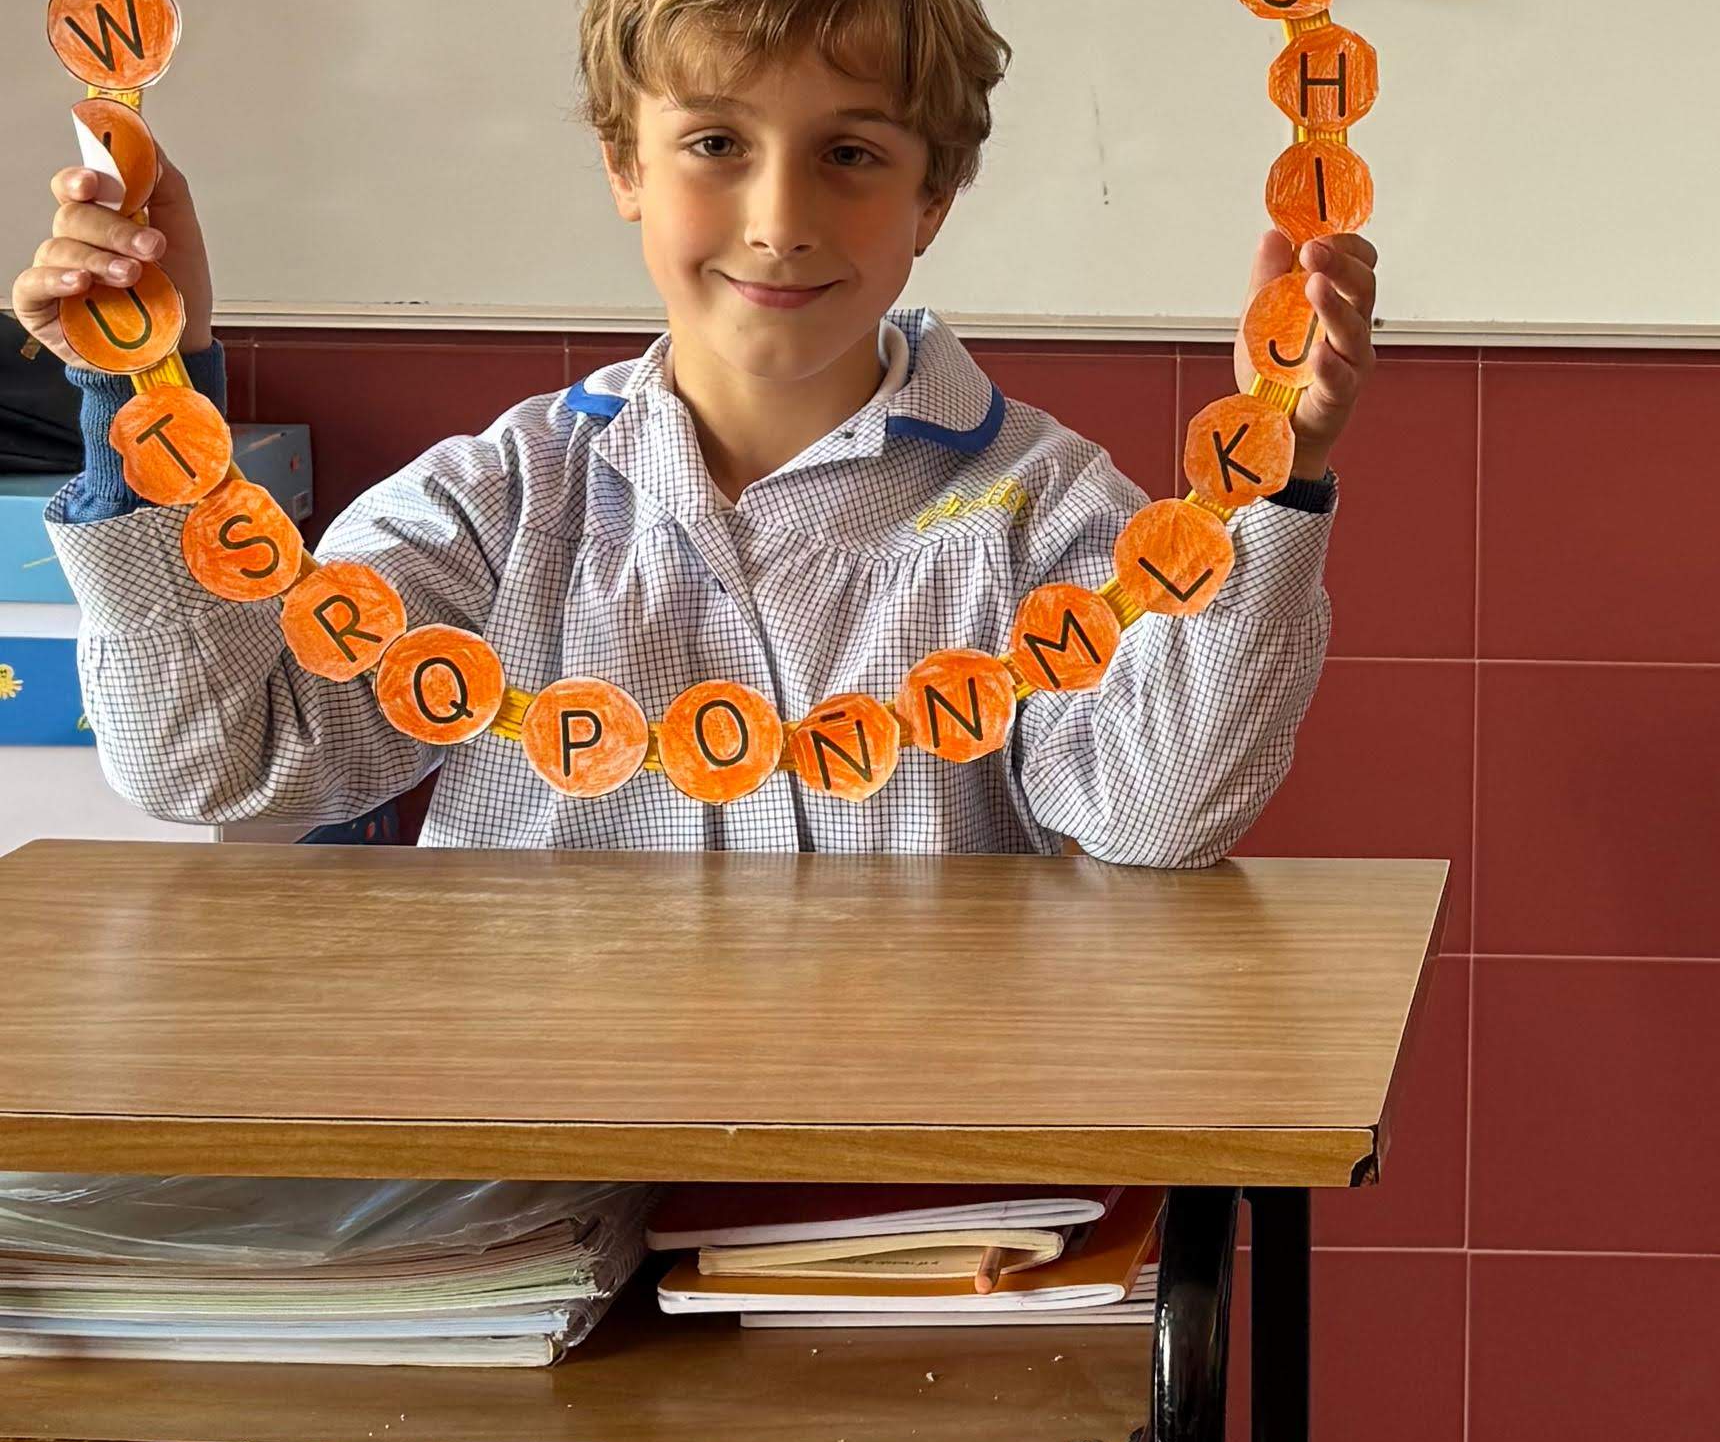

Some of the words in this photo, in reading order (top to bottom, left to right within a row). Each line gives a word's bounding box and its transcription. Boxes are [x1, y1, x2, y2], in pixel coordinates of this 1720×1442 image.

[1300, 52, 1345, 117] H
[1315, 158, 1326, 221] I
[85, 286, 152, 350] U
[1270, 311, 1320, 368] J
[136, 415, 196, 478] T
[1213, 423, 1262, 493] K
[219, 515, 279, 578] S
[1139, 558, 1212, 602] L
[314, 595, 382, 662] R
[1024, 610, 1100, 688] M
[414, 658, 473, 722] Q
[925, 678, 983, 748] N
[561, 711, 601, 776] P
[696, 700, 748, 766] O
